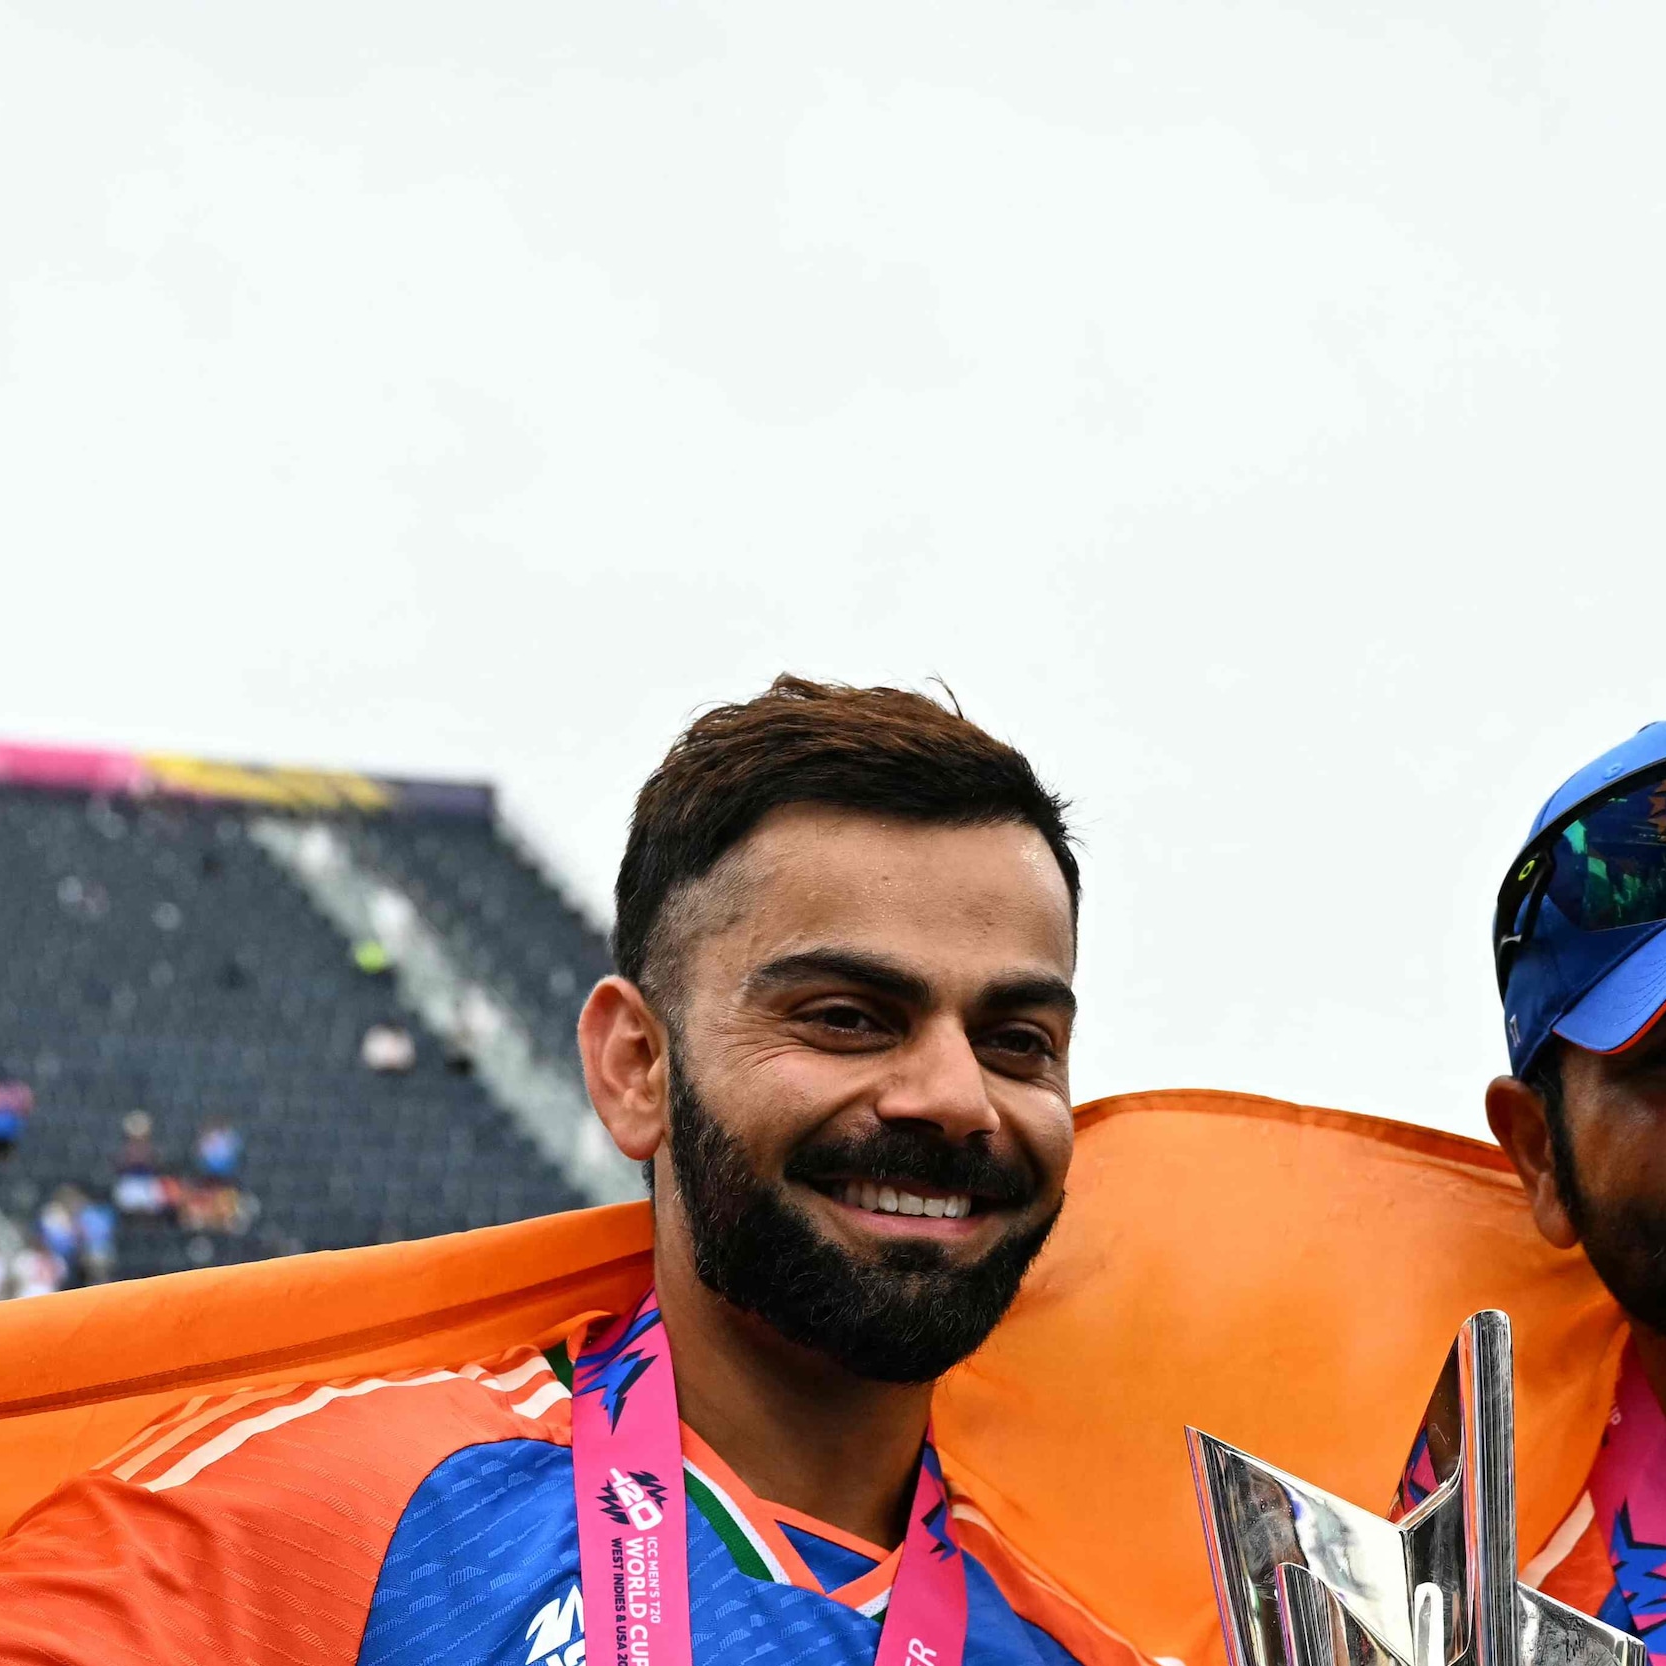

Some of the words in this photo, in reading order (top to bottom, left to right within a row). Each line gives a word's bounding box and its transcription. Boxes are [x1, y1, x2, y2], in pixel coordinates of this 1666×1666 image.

[611, 1537, 624, 1571] WEST
[647, 1536, 659, 1558] ICC
[613, 1573, 627, 1612] INDIES
[625, 1537, 649, 1619] WORLD
[648, 1560, 660, 1599] MEN'S
[615, 1614, 627, 1623] &
[650, 1602, 662, 1625] T20
[616, 1625, 628, 1651] USA
